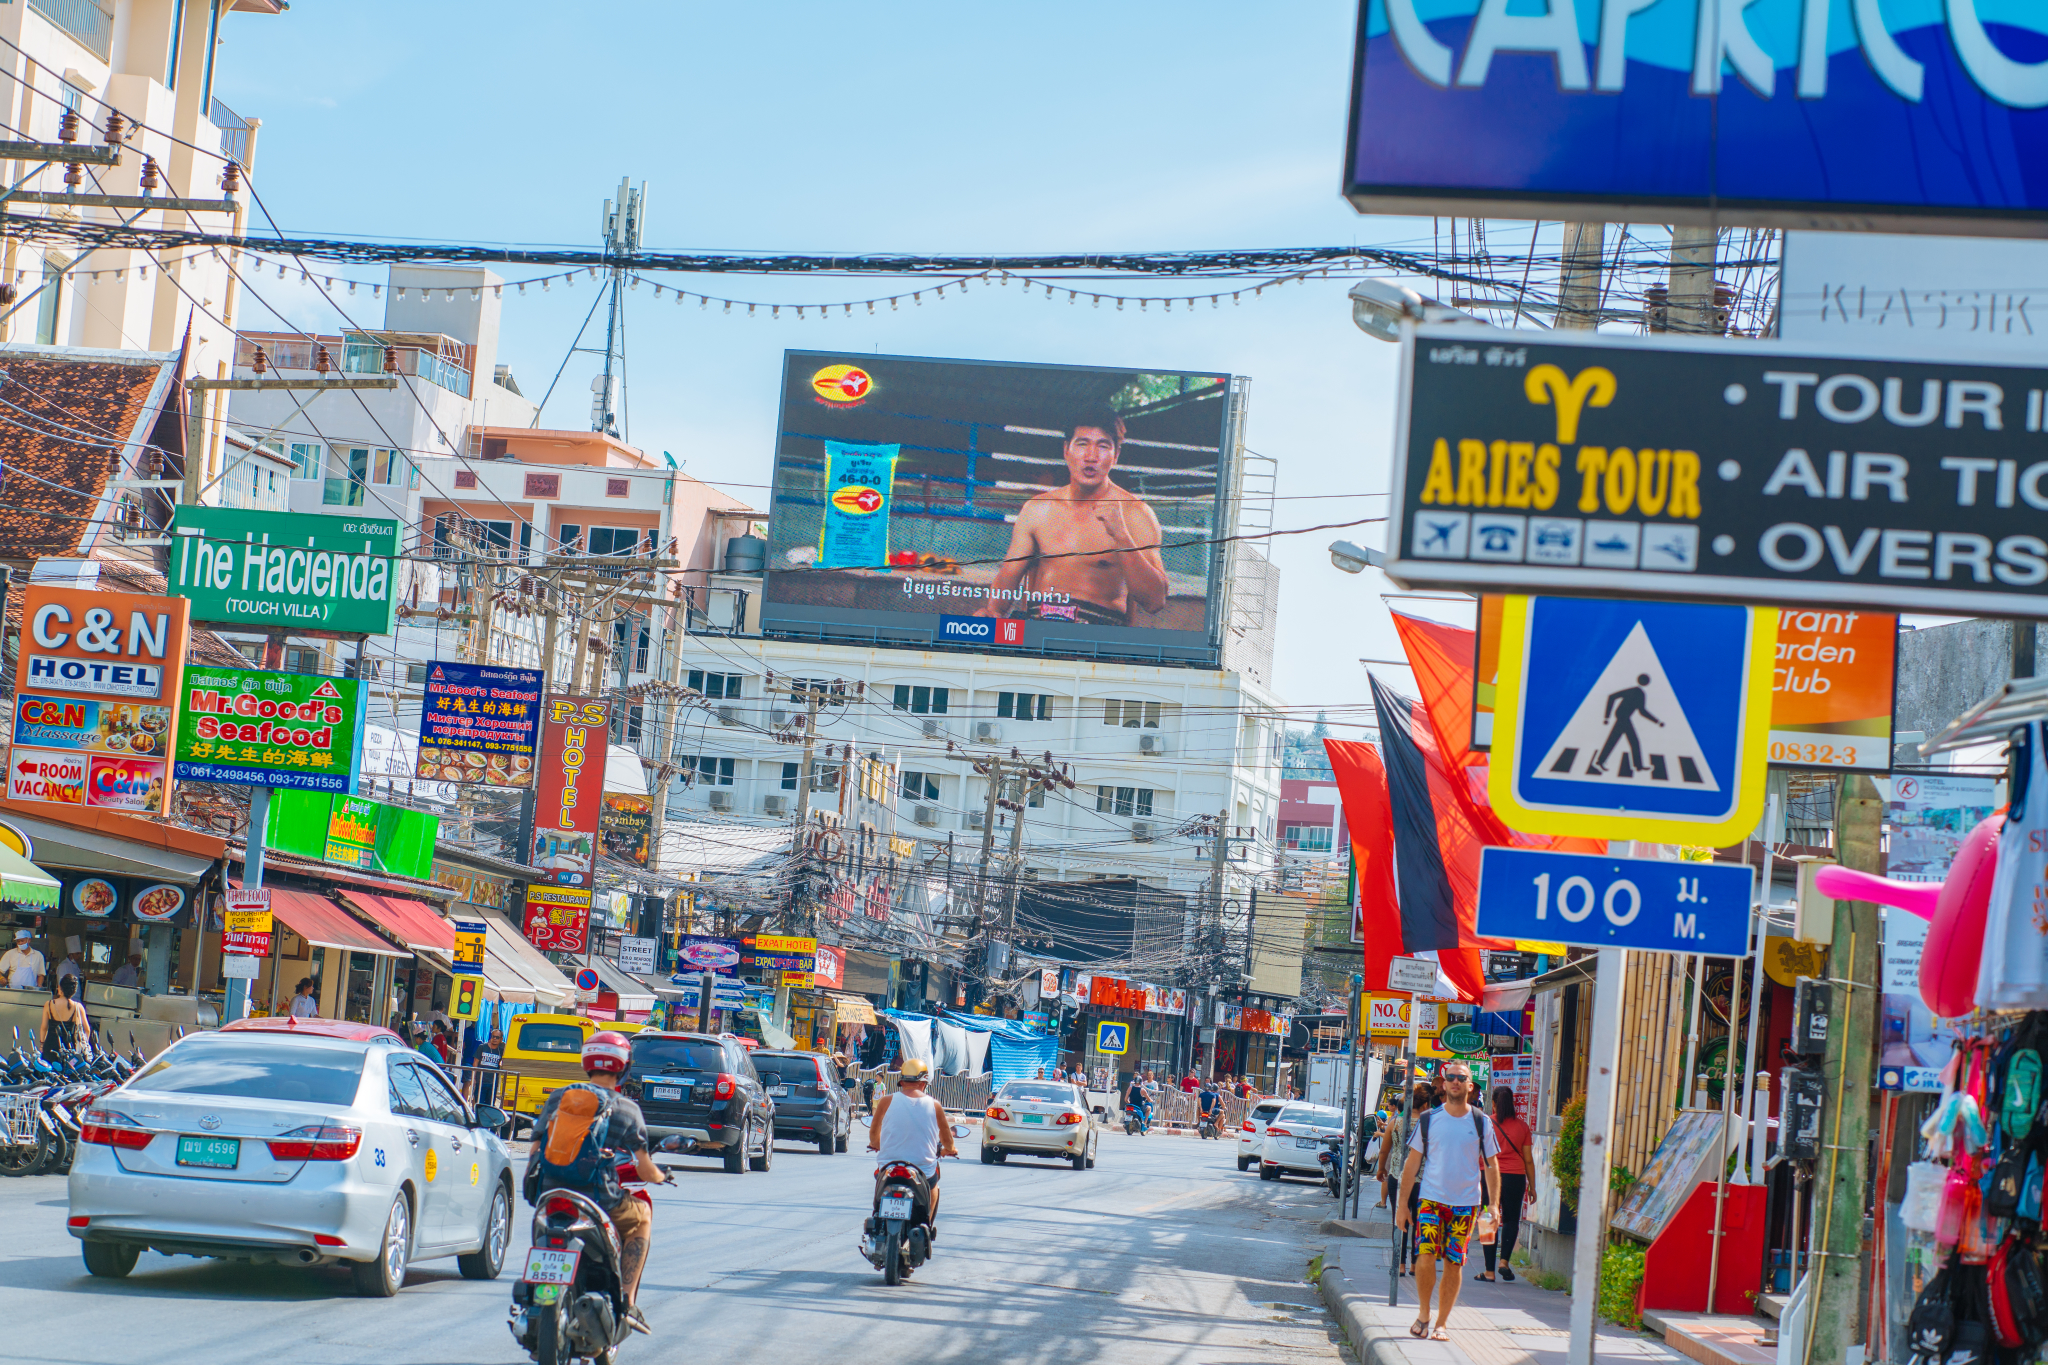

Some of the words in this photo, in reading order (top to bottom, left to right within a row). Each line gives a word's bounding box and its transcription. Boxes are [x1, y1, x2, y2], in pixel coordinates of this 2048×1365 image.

[1763, 371, 2004, 430] TOUR
[838, 473, 881, 485] 46-0-0
[1420, 437, 1562, 510] ARIES
[1576, 446, 1701, 518] TOUR
[1763, 448, 1909, 502] AIR
[176, 526, 233, 590] The
[242, 532, 388, 600] Hacienda
[225, 597, 279, 616] (TOUCH
[283, 603, 320, 619] VILLA
[32, 603, 171, 658] C&N
[946, 621, 989, 636] maco
[32, 658, 156, 686] HOTEL
[428, 682, 487, 698] Mr.Good's
[490, 687, 538, 701] Seafood
[20, 700, 86, 729] C&N
[189, 688, 343, 724] Mr.Good's
[436, 696, 528, 718] 好先生的海鲜
[549, 699, 607, 727] P.S
[196, 716, 333, 749] Seafood
[427, 712, 474, 727] Мистер
[475, 716, 533, 731] Хороший
[20, 724, 102, 746] Massage
[422, 735, 436, 744] Tel.
[437, 737, 483, 749] 076-341147,
[485, 742, 533, 753] 093-7751556
[432, 725, 525, 742] морепродукты
[189, 741, 335, 769] 好先生的海鲜
[39, 762, 82, 780] ROOM
[97, 768, 152, 796] C&N
[190, 766, 266, 784] 061-2498456,
[268, 773, 343, 790] 093-7751556
[559, 726, 587, 829] HOTEL
[14, 779, 80, 799] VACANCY
[98, 794, 124, 805] Beauty
[125, 796, 145, 806] Salon
[226, 890, 246, 902] THAI
[248, 890, 269, 902] FOOD
[529, 891, 541, 900] P.S
[543, 892, 589, 905] RESTAURANT
[1533, 872, 1642, 927] 100
[1676, 877, 1708, 904] ม.
[549, 907, 577, 927] 餐厅
[1673, 912, 1706, 940] M.
[527, 926, 582, 951] P.S
[622, 945, 652, 954] STREET
[757, 938, 784, 949] EXPAT
[786, 940, 814, 950] HOTEL
[1374, 1003, 1396, 1017] NO.
[1373, 1022, 1436, 1030] RESTAUANT
[1705, 1067, 1746, 1083] Chg
[207, 1142, 236, 1155] 4596
[374, 1147, 386, 1168] 33
[532, 1271, 563, 1281] 8551
